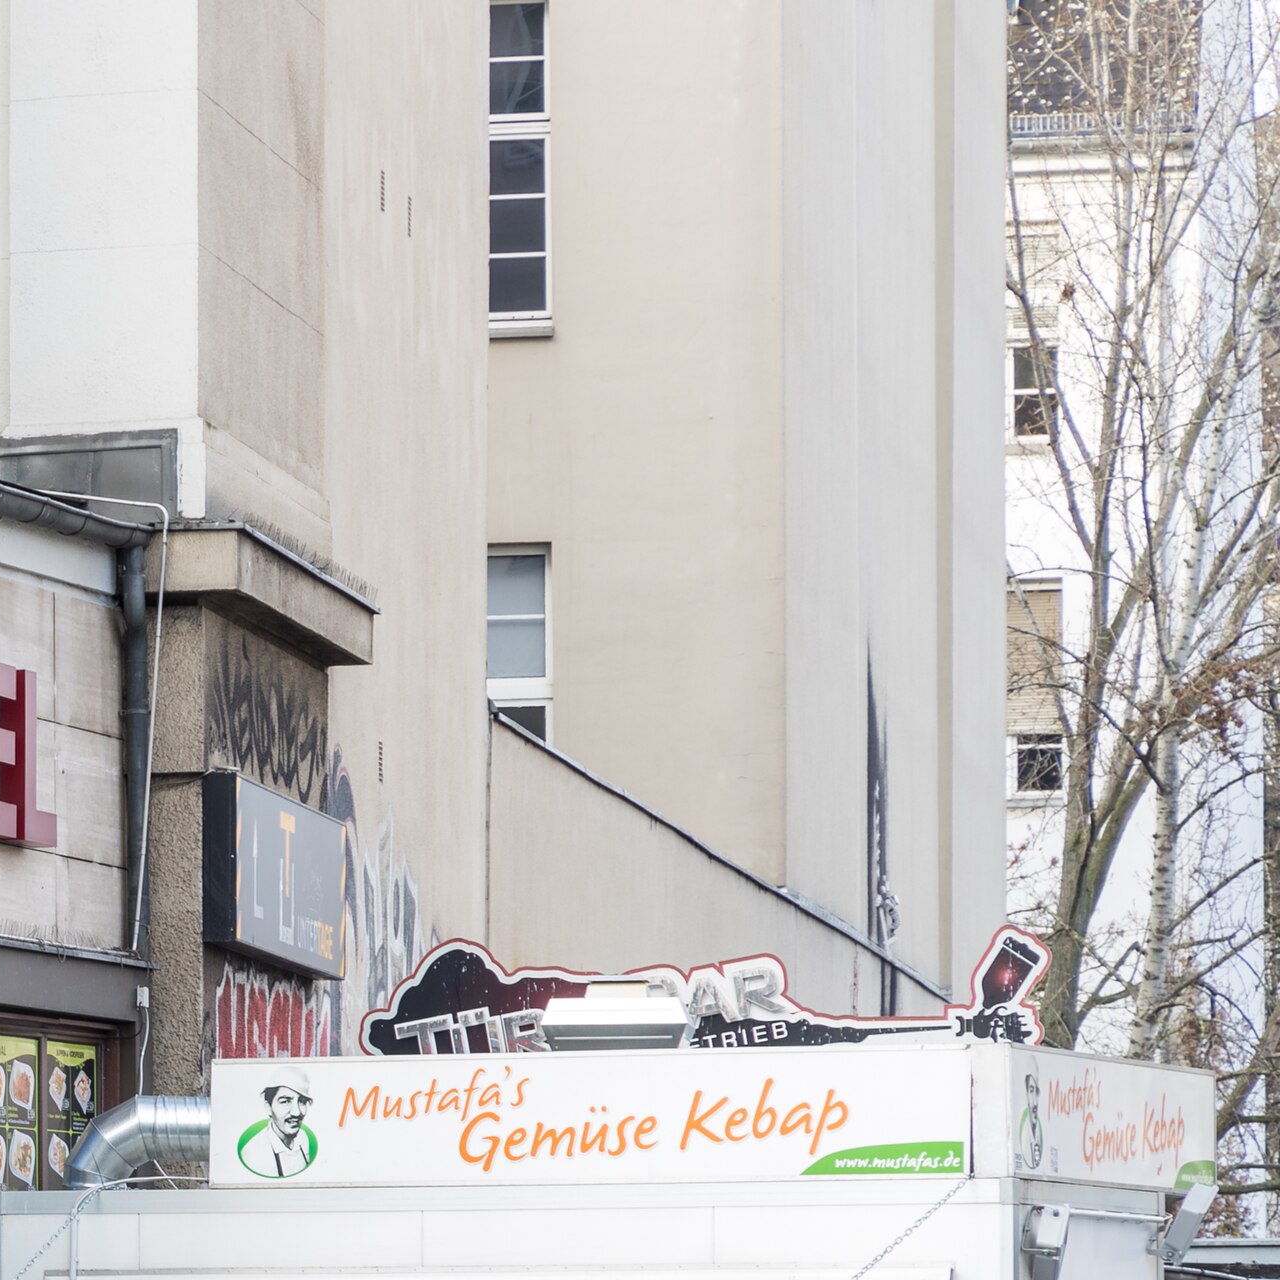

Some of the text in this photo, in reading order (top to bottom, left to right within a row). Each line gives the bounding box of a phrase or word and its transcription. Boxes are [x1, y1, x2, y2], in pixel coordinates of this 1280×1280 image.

[339, 1066, 532, 1127] Mustafa's
[1048, 1067, 1101, 1121] Mustafa's
[458, 1078, 851, 1173] Gemüse Kebap
[1082, 1092, 1185, 1173] Gemüse Kebap
[834, 1149, 962, 1172] www.mustafas.de
